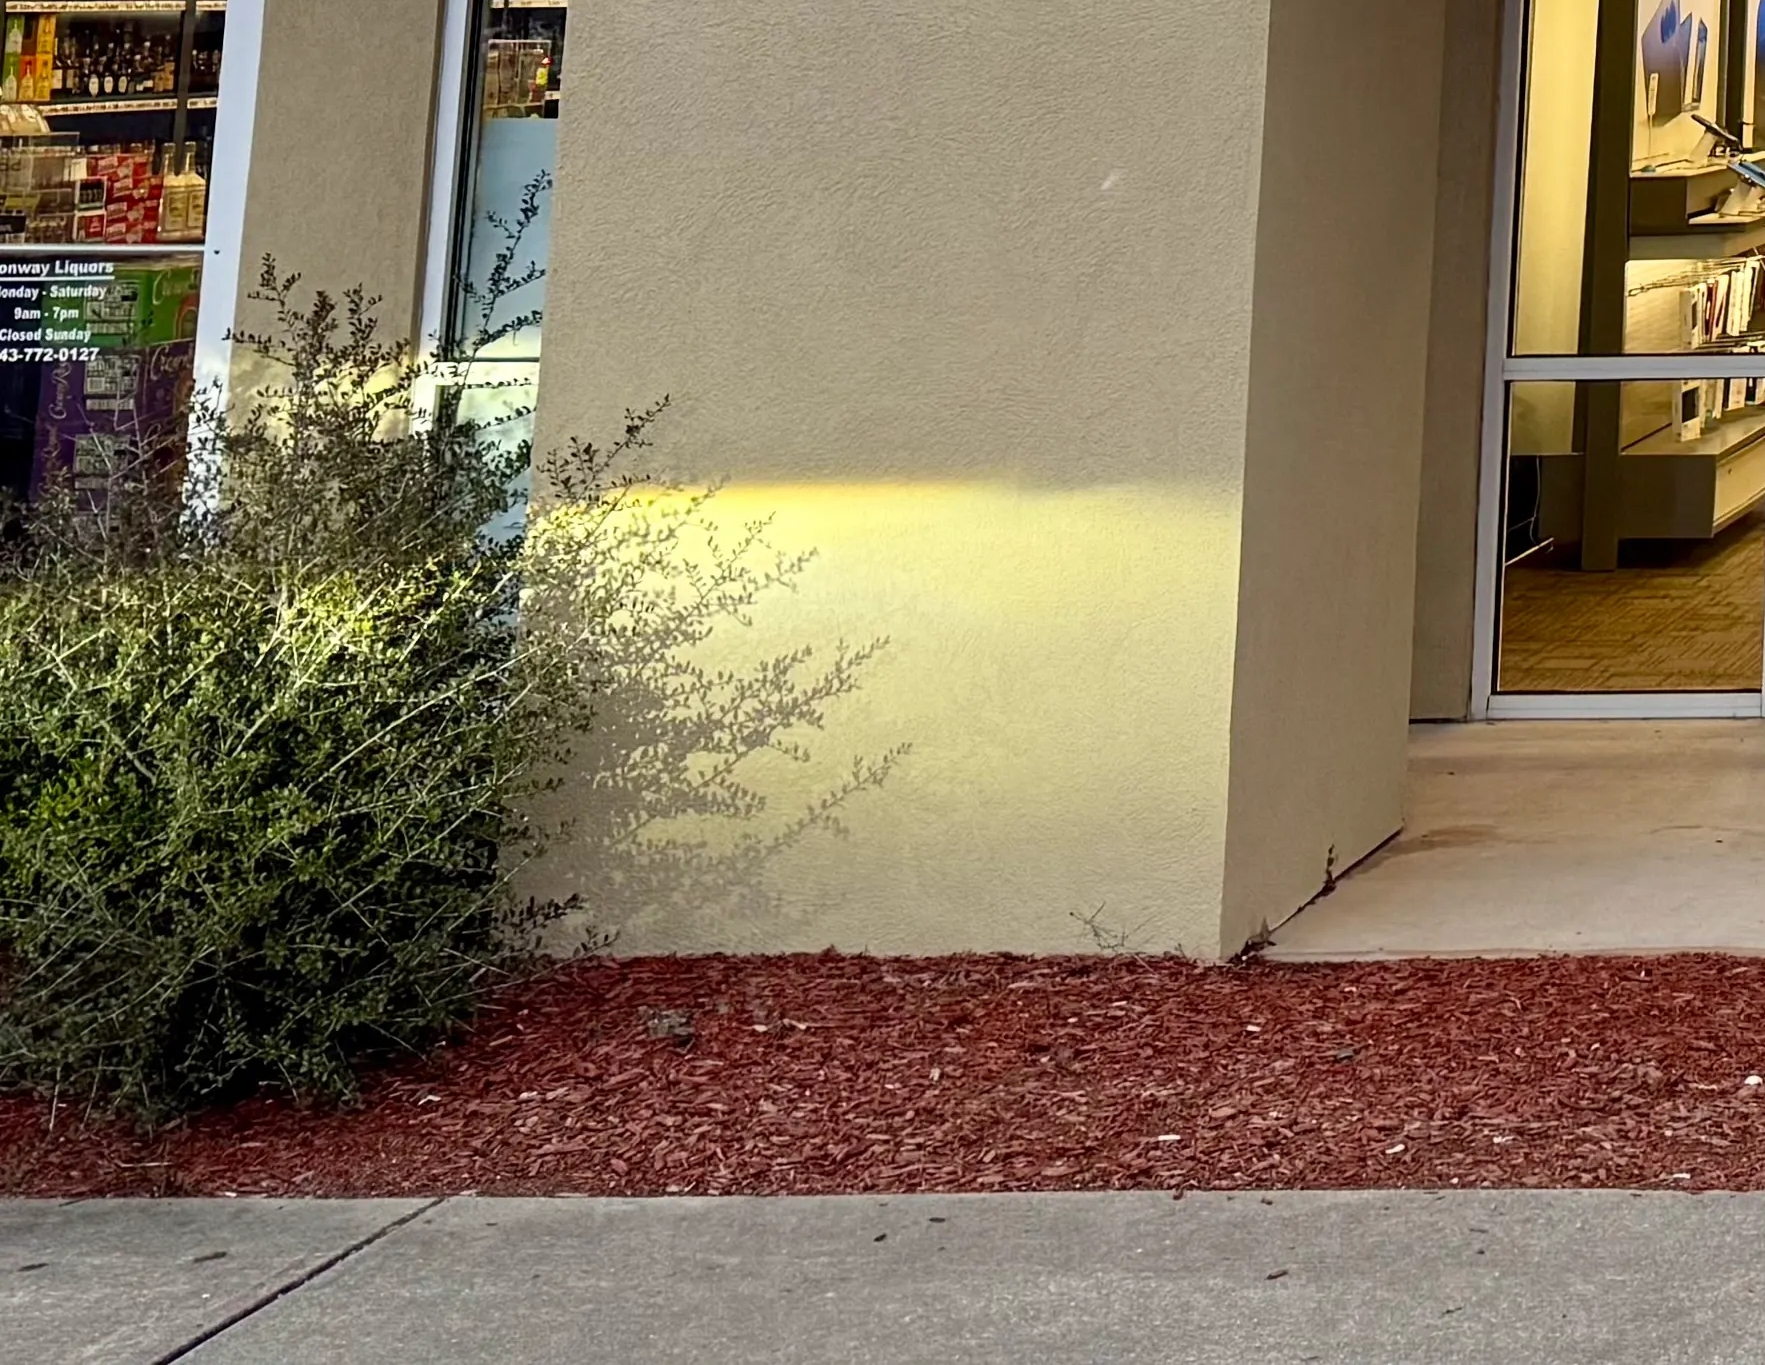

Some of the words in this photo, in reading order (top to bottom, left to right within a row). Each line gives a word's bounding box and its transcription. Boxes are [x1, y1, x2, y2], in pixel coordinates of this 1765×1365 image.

[54, 259, 115, 277] Liquors
[50, 285, 108, 302] Saturday
[14, 307, 41, 320] 9am
[52, 307, 79, 322] 7pm
[0, 328, 42, 341] Closed
[45, 328, 91, 343] Sunday
